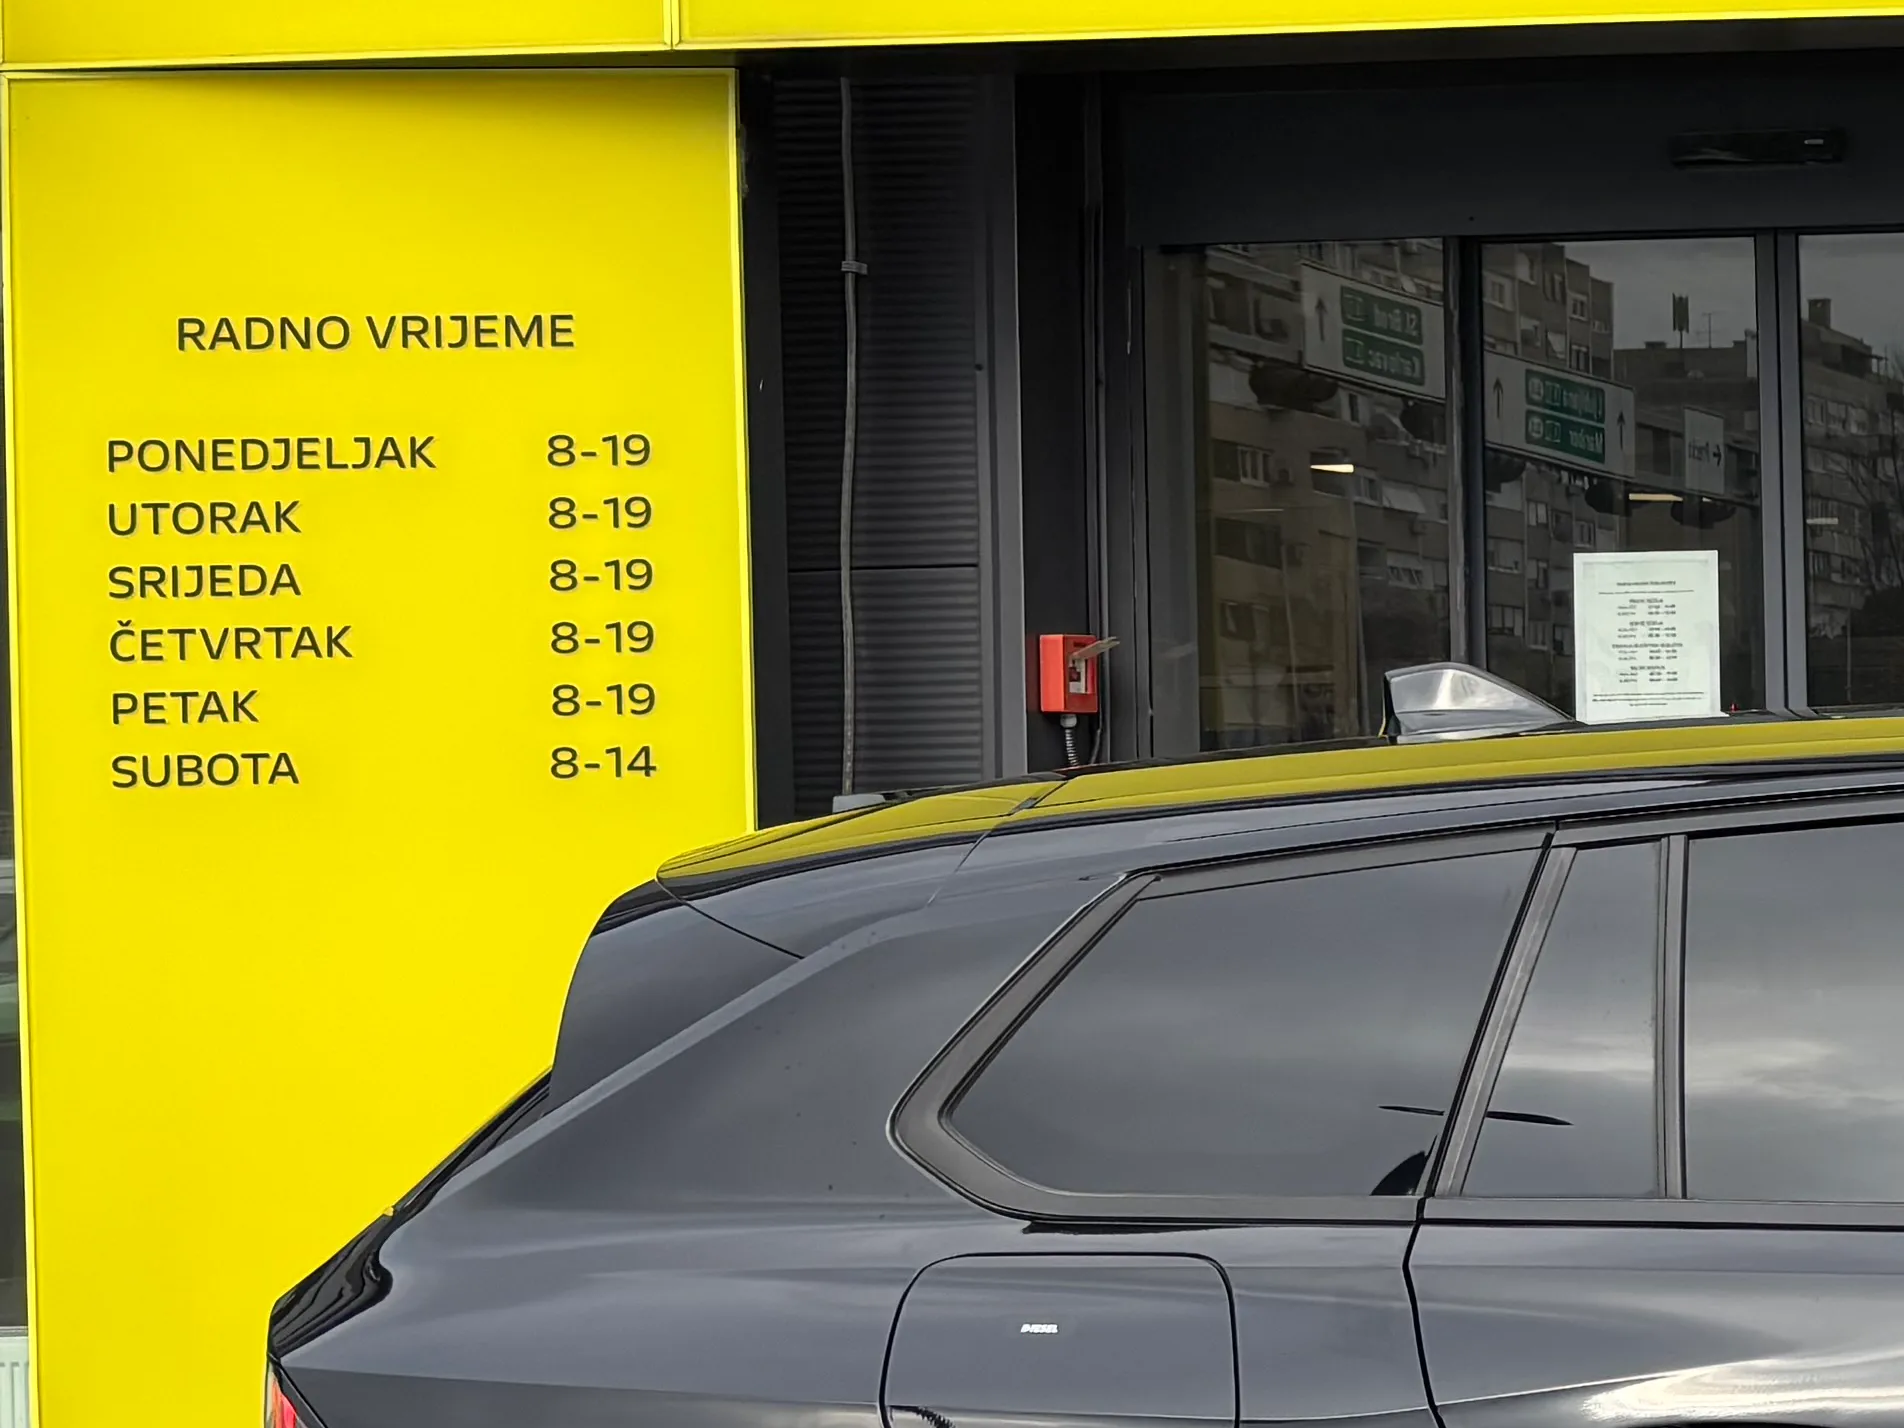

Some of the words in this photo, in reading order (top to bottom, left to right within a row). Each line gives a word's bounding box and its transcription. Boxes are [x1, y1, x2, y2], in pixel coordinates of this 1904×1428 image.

[178, 315, 350, 351] RADNO
[366, 314, 574, 349] VRIJEME
[108, 436, 436, 473] PONEDJELJAK
[547, 434, 651, 467] 8-19
[108, 500, 301, 536] UTORAK
[548, 496, 652, 529] 8-19
[108, 563, 301, 599] SRIJEDA
[549, 558, 653, 592] 8-19
[110, 620, 353, 662] ČETVRTAK
[551, 620, 654, 654] 8-19
[112, 690, 258, 725] PETAK
[552, 683, 656, 717] 8-19
[112, 752, 299, 789] SUBOTA
[550, 745, 657, 779] 8-14
